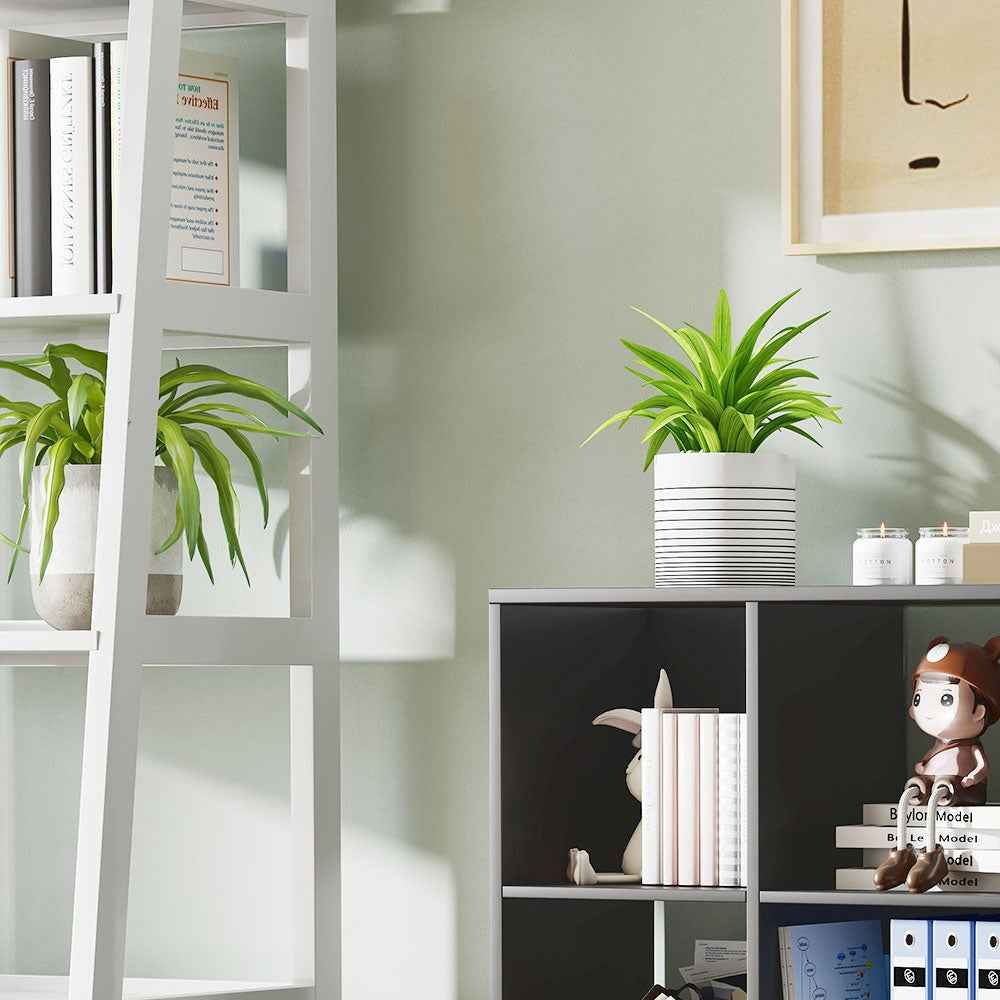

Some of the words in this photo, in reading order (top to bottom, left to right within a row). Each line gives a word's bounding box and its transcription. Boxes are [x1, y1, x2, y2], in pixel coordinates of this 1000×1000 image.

[936, 811, 973, 823] Model
[939, 834, 978, 843] Model
[944, 854, 973, 867] odel
